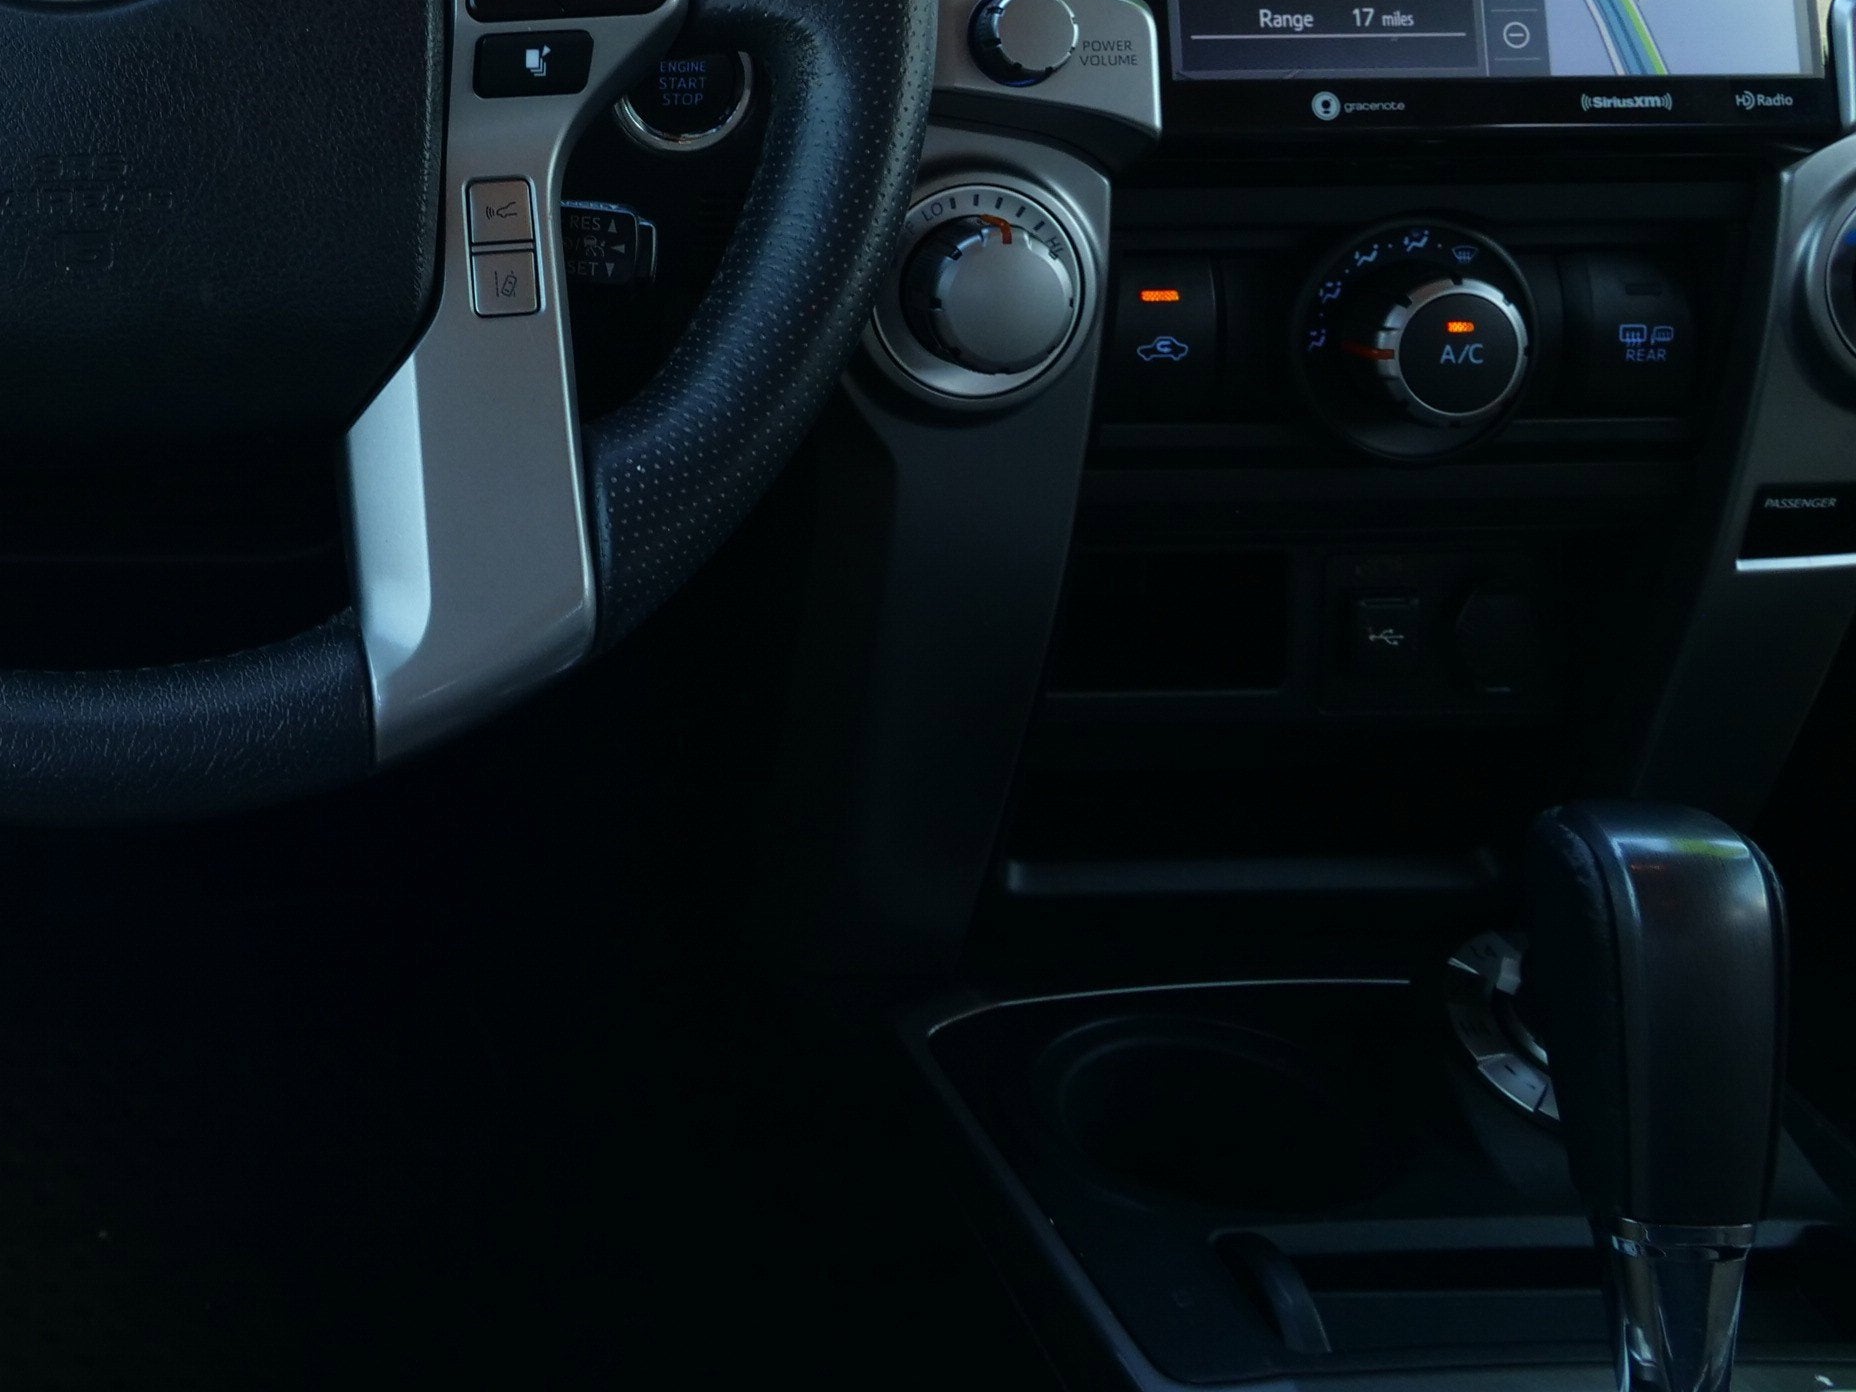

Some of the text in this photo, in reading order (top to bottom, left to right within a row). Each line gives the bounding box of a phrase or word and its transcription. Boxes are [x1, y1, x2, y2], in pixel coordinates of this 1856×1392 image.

[1259, 8, 1414, 31] Range 17 miles
[1082, 40, 1134, 52] POWER
[659, 60, 706, 73] ENGINE
[1079, 54, 1138, 67] VOLUME
[659, 76, 706, 90] START
[662, 92, 704, 106] STOP
[1757, 93, 1793, 108] Radio
[1343, 100, 1406, 114] gracenote
[921, 201, 943, 222] LO
[569, 215, 601, 231] RES
[567, 261, 599, 276] SET
[1440, 343, 1485, 365] A/C
[1624, 349, 1667, 362] REAR
[1764, 497, 1837, 509] PASSENGER
